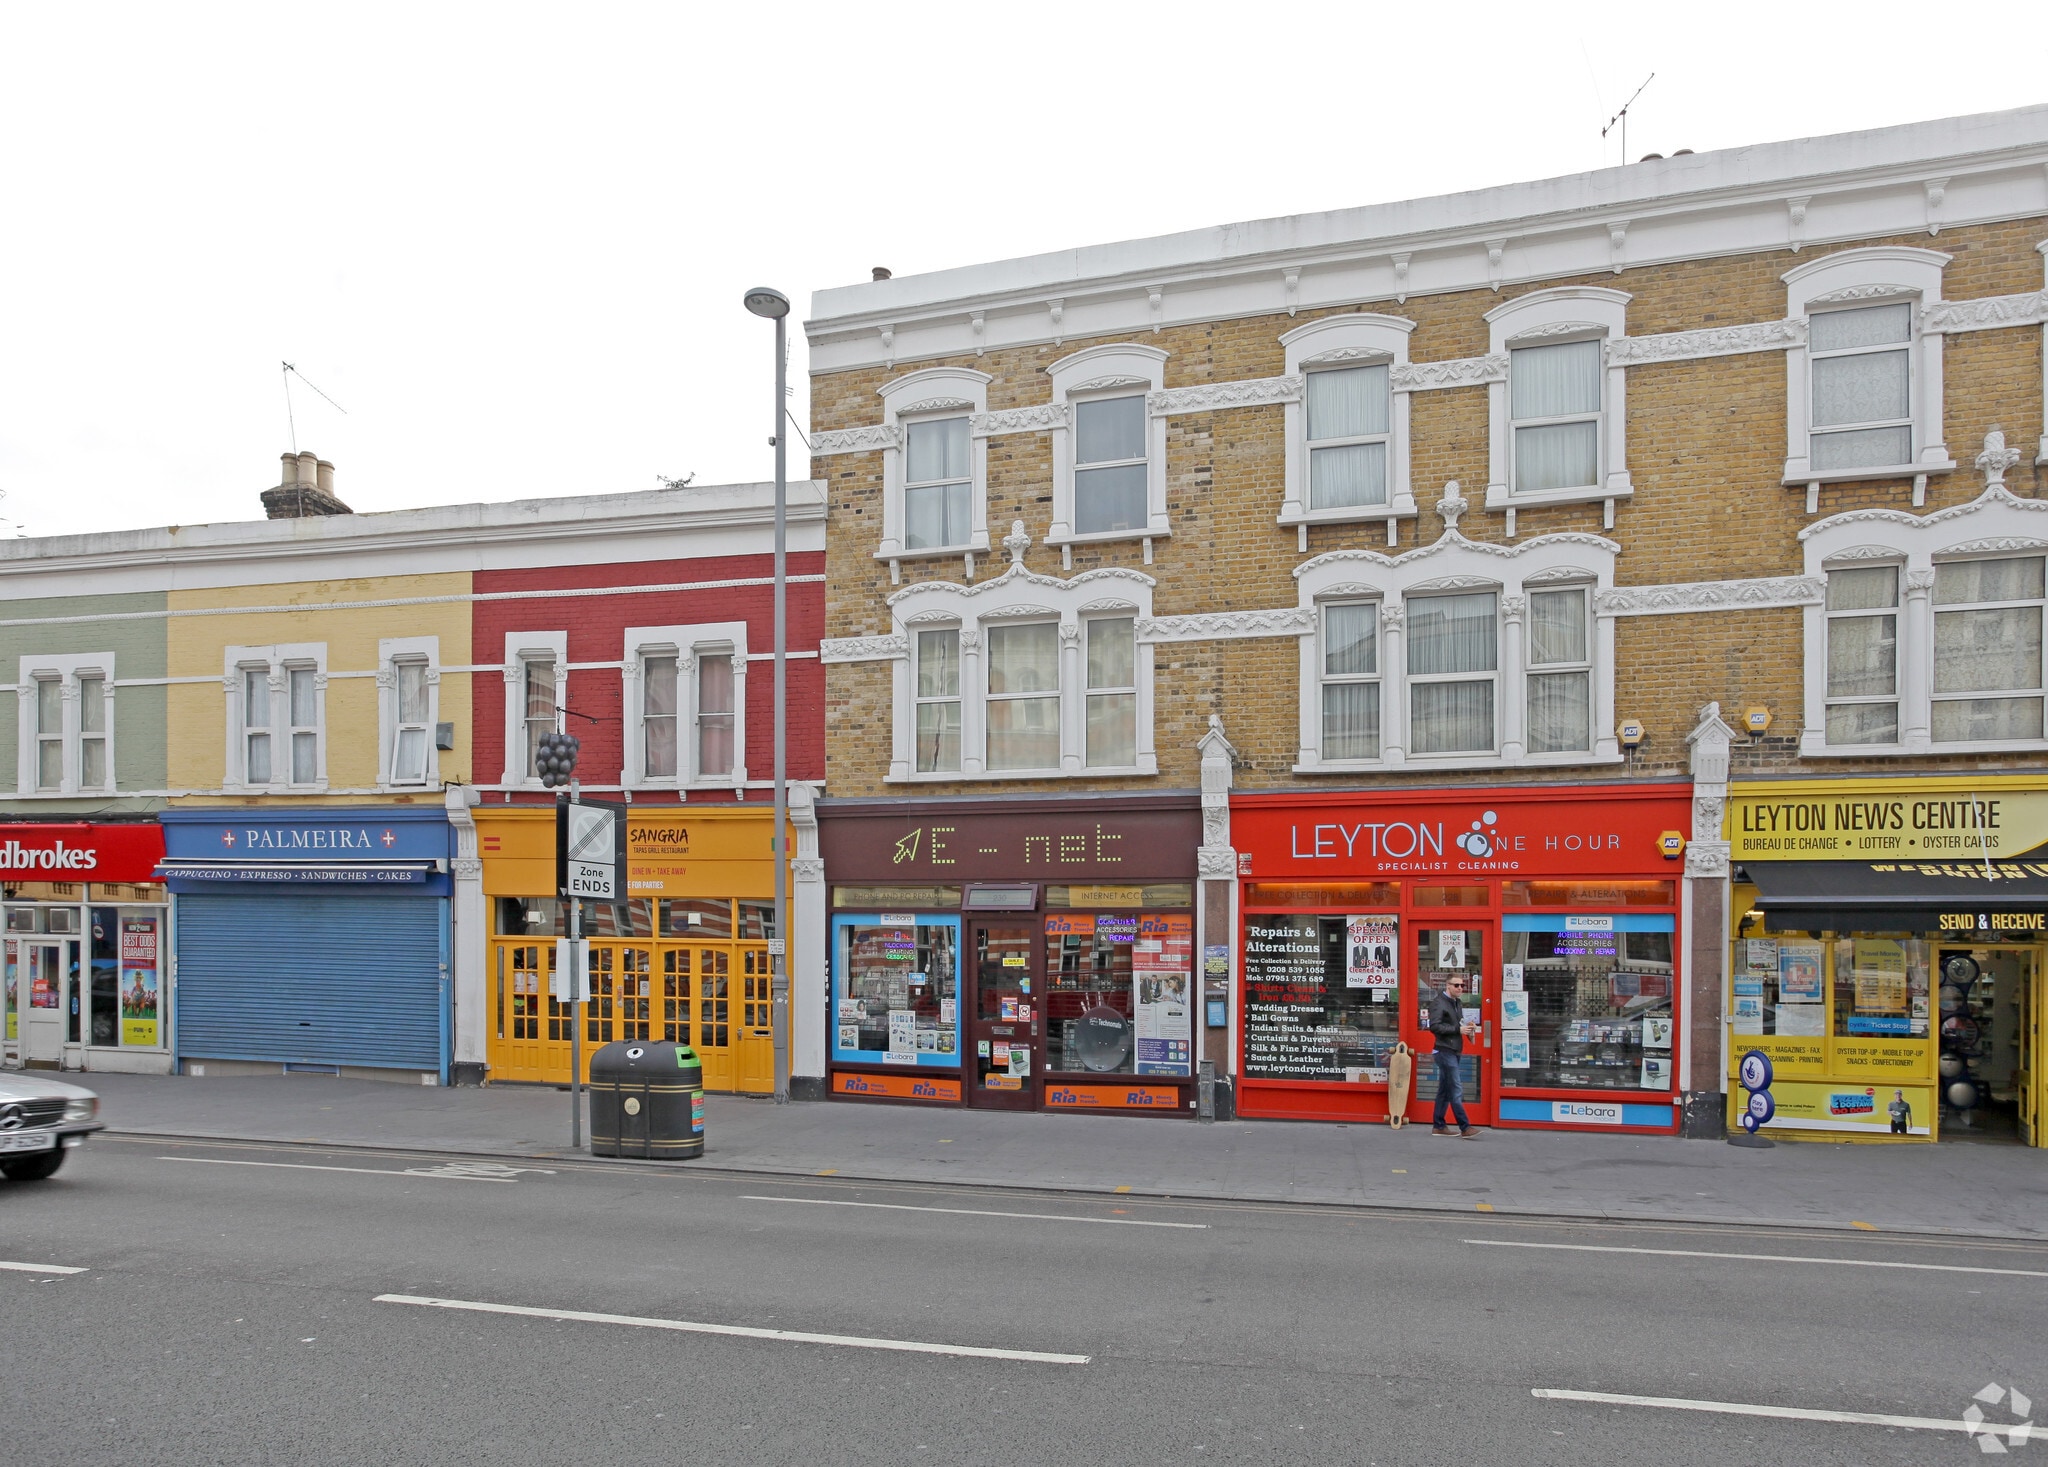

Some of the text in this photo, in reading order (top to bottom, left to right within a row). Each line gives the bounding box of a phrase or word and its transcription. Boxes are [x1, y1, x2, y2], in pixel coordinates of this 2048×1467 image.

[1743, 801, 2000, 831] LEYTON NEWS CENTRE
[245, 829, 372, 849] PALMEIRA
[630, 828, 689, 845] SANGRIA
[1291, 822, 1621, 858] LEYTON HOUR
[932, 823, 1122, 864] E net
[1664, 838, 1679, 847] ADT
[1743, 838, 1781, 850] BUREAU
[1784, 838, 1796, 850] DE
[1798, 837, 1839, 850] CHANGE
[1859, 836, 1901, 849] LOTTERY
[1922, 835, 1961, 848] OYSTER
[0, 840, 97, 869] dbrokes
[633, 846, 689, 854] TAPAS GRILL RESTAURANT
[1377, 861, 1519, 871] SPECIALIST CLEANING
[1870, 864, 2021, 872] WESTERN
[165, 870, 412, 881] CAPPUCCINO EXPRESSO SANDWICHES CAKES
[580, 866, 603, 877] Zone
[632, 867, 687, 876] DINE IN TAKE AWAY
[1920, 869, 2028, 879] UNION
[572, 879, 611, 893] ENDS
[632, 881, 642, 889] FOR
[643, 881, 664, 889] PARTIES
[854, 892, 879, 900] PHONE
[882, 892, 899, 900] AND
[1081, 891, 1154, 900] INTERNET ACCESS
[1255, 890, 1389, 900] FREE COLLECTION DELIVERY
[1528, 888, 1647, 898] REPAIRS & ALTERATIONS
[1045, 916, 1071, 932] Ria
[1142, 916, 1169, 932] Ria
[1577, 917, 1608, 926] Lebara
[1939, 913, 2046, 930] SEND & RECEIVE
[1250, 926, 1316, 939] Repairs &
[1349, 926, 1396, 934] SPECIAL
[1587, 931, 1615, 939] PHONE
[124, 935, 139, 947] BEST
[1108, 934, 1136, 942] REPAIR
[1353, 935, 1391, 944] OFFER
[1557, 939, 1613, 947] ACCESSORIES
[1245, 941, 1320, 953] Alterations
[1554, 947, 1586, 955] UNLOCKING
[124, 947, 156, 958] GUARANTEED
[1300, 958, 1326, 966] Delivery
[1367, 959, 1384, 967] Suits
[1349, 966, 1375, 974] Cleaned
[1366, 974, 1396, 985] £9.98
[1259, 993, 1279, 1001] Iron
[1251, 1004, 1324, 1013] Wedding Dresses
[1098, 1018, 1122, 1029] Technomate
[1892, 1023, 1909, 1031] Stop
[1251, 1024, 1279, 1032] Indian
[1281, 1025, 1304, 1033] Suits
[1316, 1026, 1338, 1034] Saris
[1251, 1034, 1289, 1042] Curtains
[1300, 1035, 1331, 1043] Duvets
[1302, 1045, 1335, 1053] Fabrics
[1736, 1045, 1771, 1053] NEWSPAPERS
[1775, 1046, 1806, 1054] MAGAZINES
[1837, 1047, 1857, 1055] OYSTER
[1858, 1048, 1878, 1056] TOP-UP
[891, 1053, 914, 1061] Lebara
[1251, 1054, 1277, 1062] Suede
[1289, 1055, 1323, 1063] Leather
[1768, 1055, 1823, 1064] SCANNING PRINTING
[1846, 1057, 1914, 1067] SNACKS CONFECTIONERY
[845, 1076, 868, 1091] Ria
[987, 1078, 1001, 1087] Ria
[912, 1081, 937, 1096] Ria
[1051, 1088, 1077, 1103] Ria
[1126, 1088, 1153, 1105] Ria
[1571, 1105, 1616, 1117] Lebara
